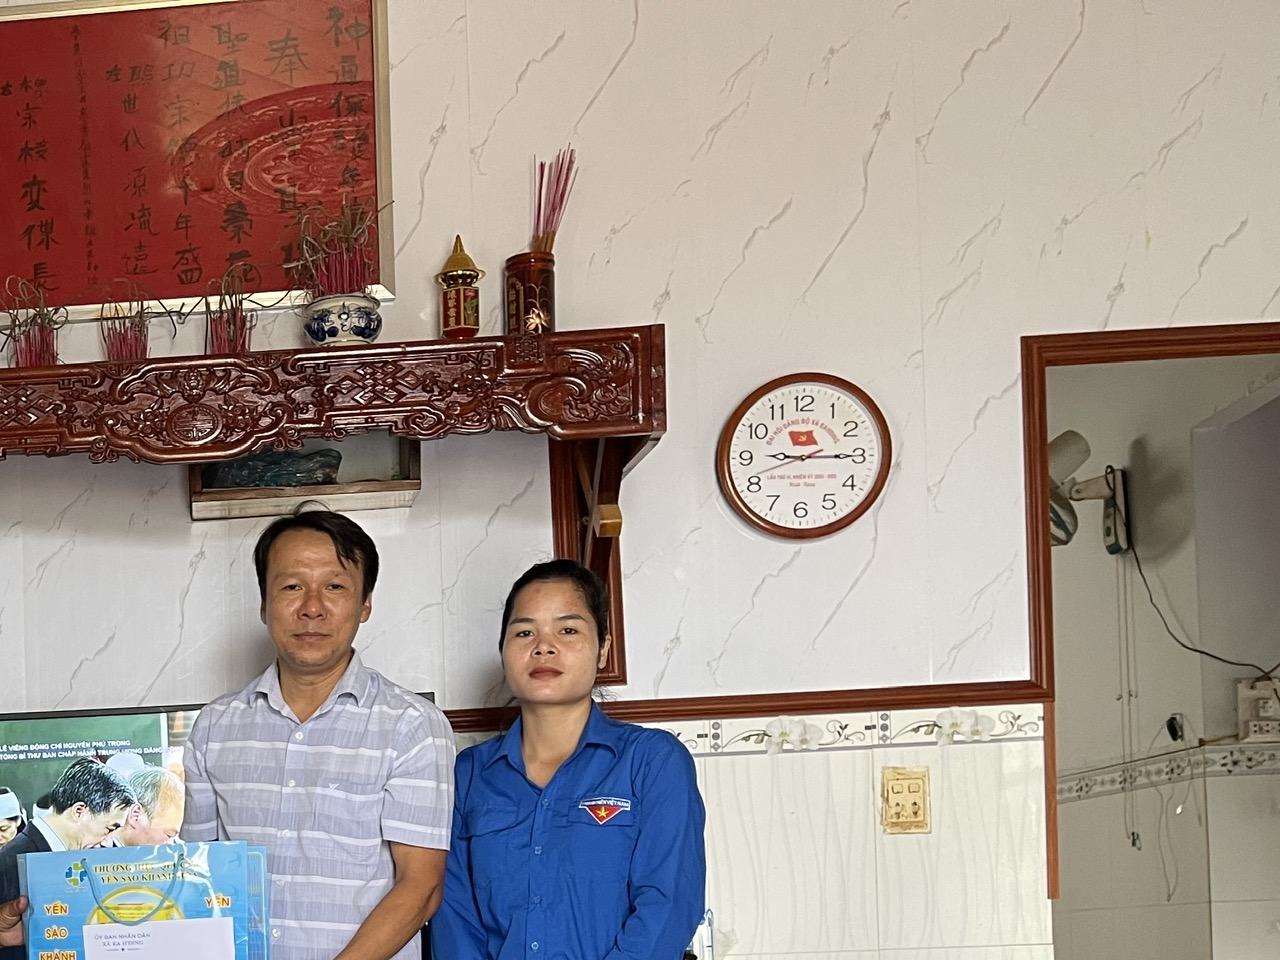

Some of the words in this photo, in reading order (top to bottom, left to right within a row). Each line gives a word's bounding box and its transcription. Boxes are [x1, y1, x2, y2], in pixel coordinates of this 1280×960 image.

[770, 404, 784, 420] 11
[794, 395, 814, 412] 12
[830, 403, 835, 419] 1
[748, 423, 768, 440] 10
[843, 420, 858, 437] 2
[739, 450, 753, 466] 9
[852, 447, 866, 464] 3
[747, 475, 762, 493] 8
[842, 474, 856, 491] 4
[766, 495, 780, 511] 7
[793, 501, 808, 518] 6
[821, 493, 837, 511] 5
[45, 901, 69, 916] YẾN
[205, 893, 231, 908] YẾN
